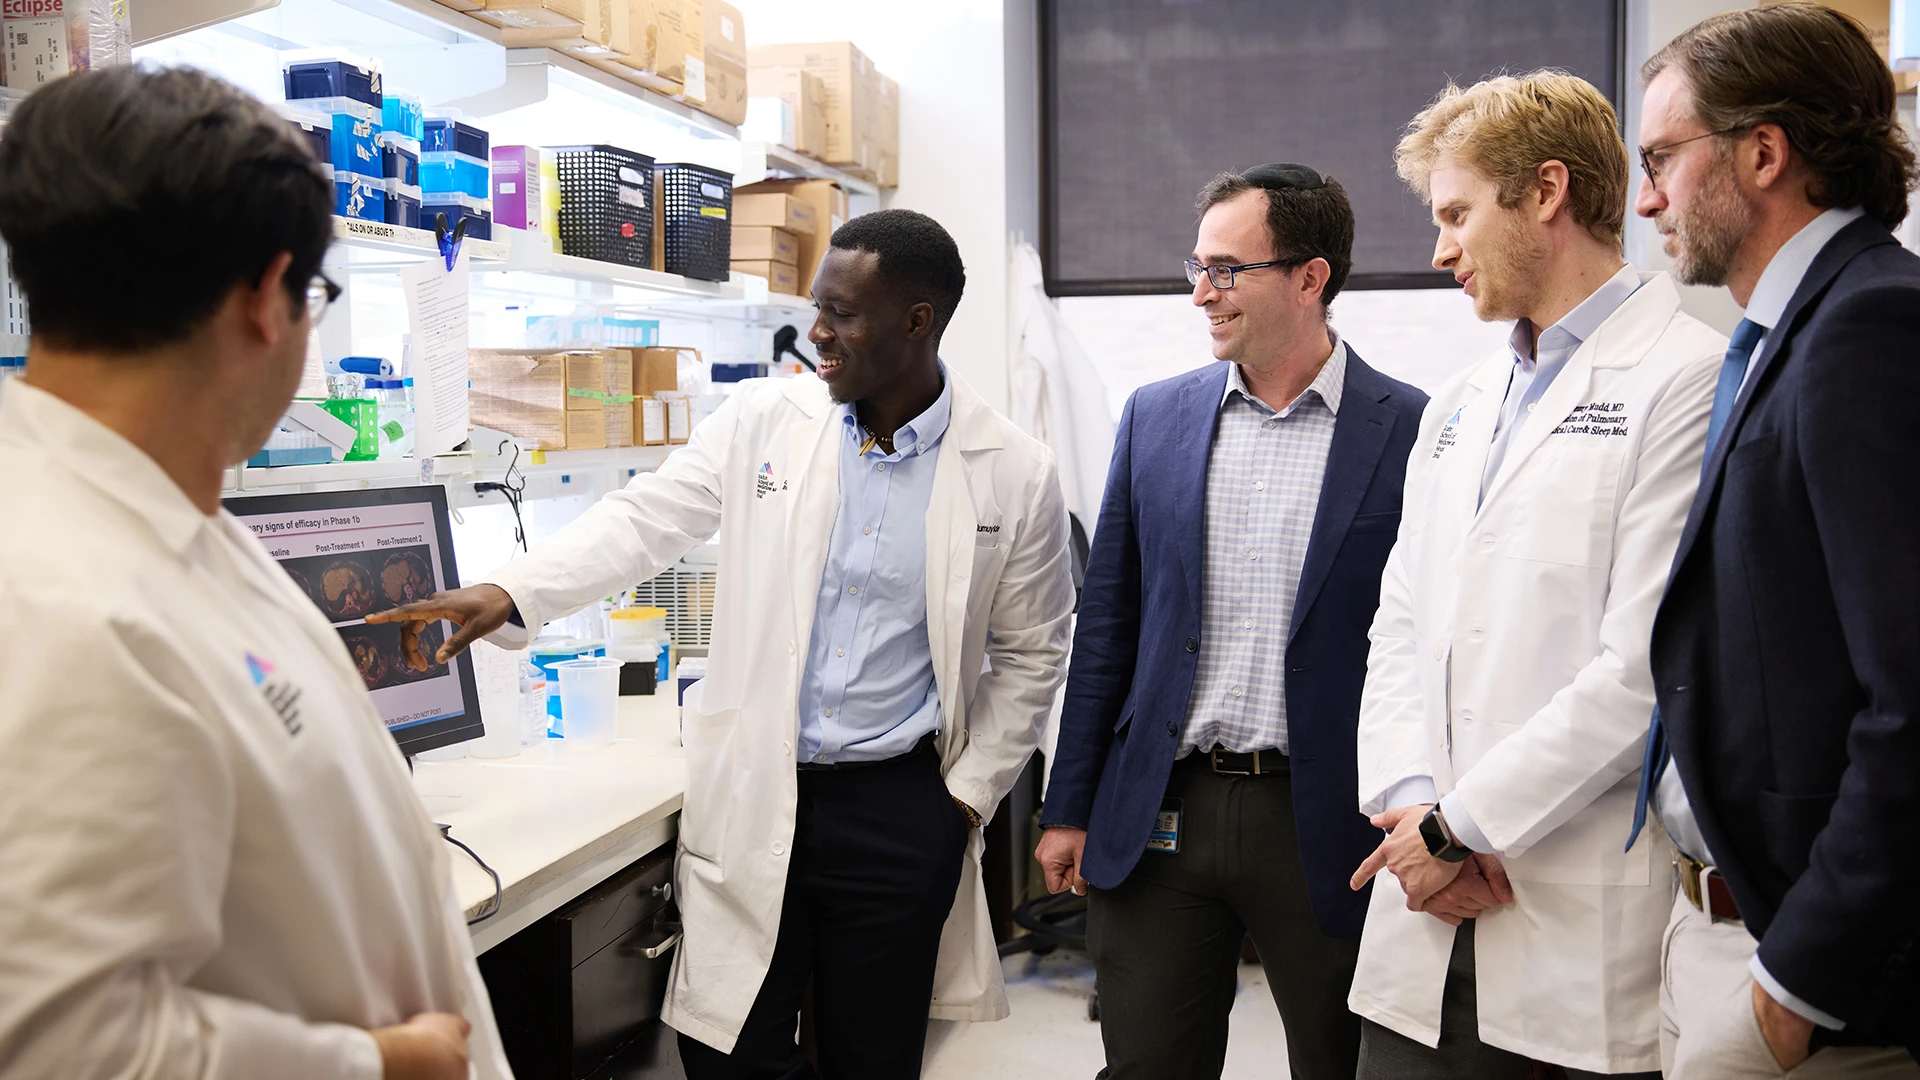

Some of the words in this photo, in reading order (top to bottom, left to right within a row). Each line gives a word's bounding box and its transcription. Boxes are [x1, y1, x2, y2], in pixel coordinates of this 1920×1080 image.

[3, 0, 63, 16] Eclipse
[347, 222, 358, 233] ALS
[359, 224, 366, 233] ON
[367, 225, 373, 235] OR
[374, 227, 389, 237] ABOVE
[1611, 403, 1624, 412] MD
[1578, 413, 1587, 422] of
[1586, 413, 1627, 425] Pulmonary
[1590, 426, 1611, 438] Sleep
[1611, 427, 1628, 436] Med
[265, 521, 284, 533] signs
[286, 519, 294, 529] of
[294, 517, 321, 529] efficacy
[322, 517, 330, 526] in
[330, 516, 351, 525] Phase
[352, 515, 361, 524] 1b
[377, 536, 416, 546] Post-Treatment
[417, 534, 423, 542] 2
[269, 548, 290, 557] seline
[316, 541, 359, 553] Post-Treatment
[430, 708, 442, 716] POST
